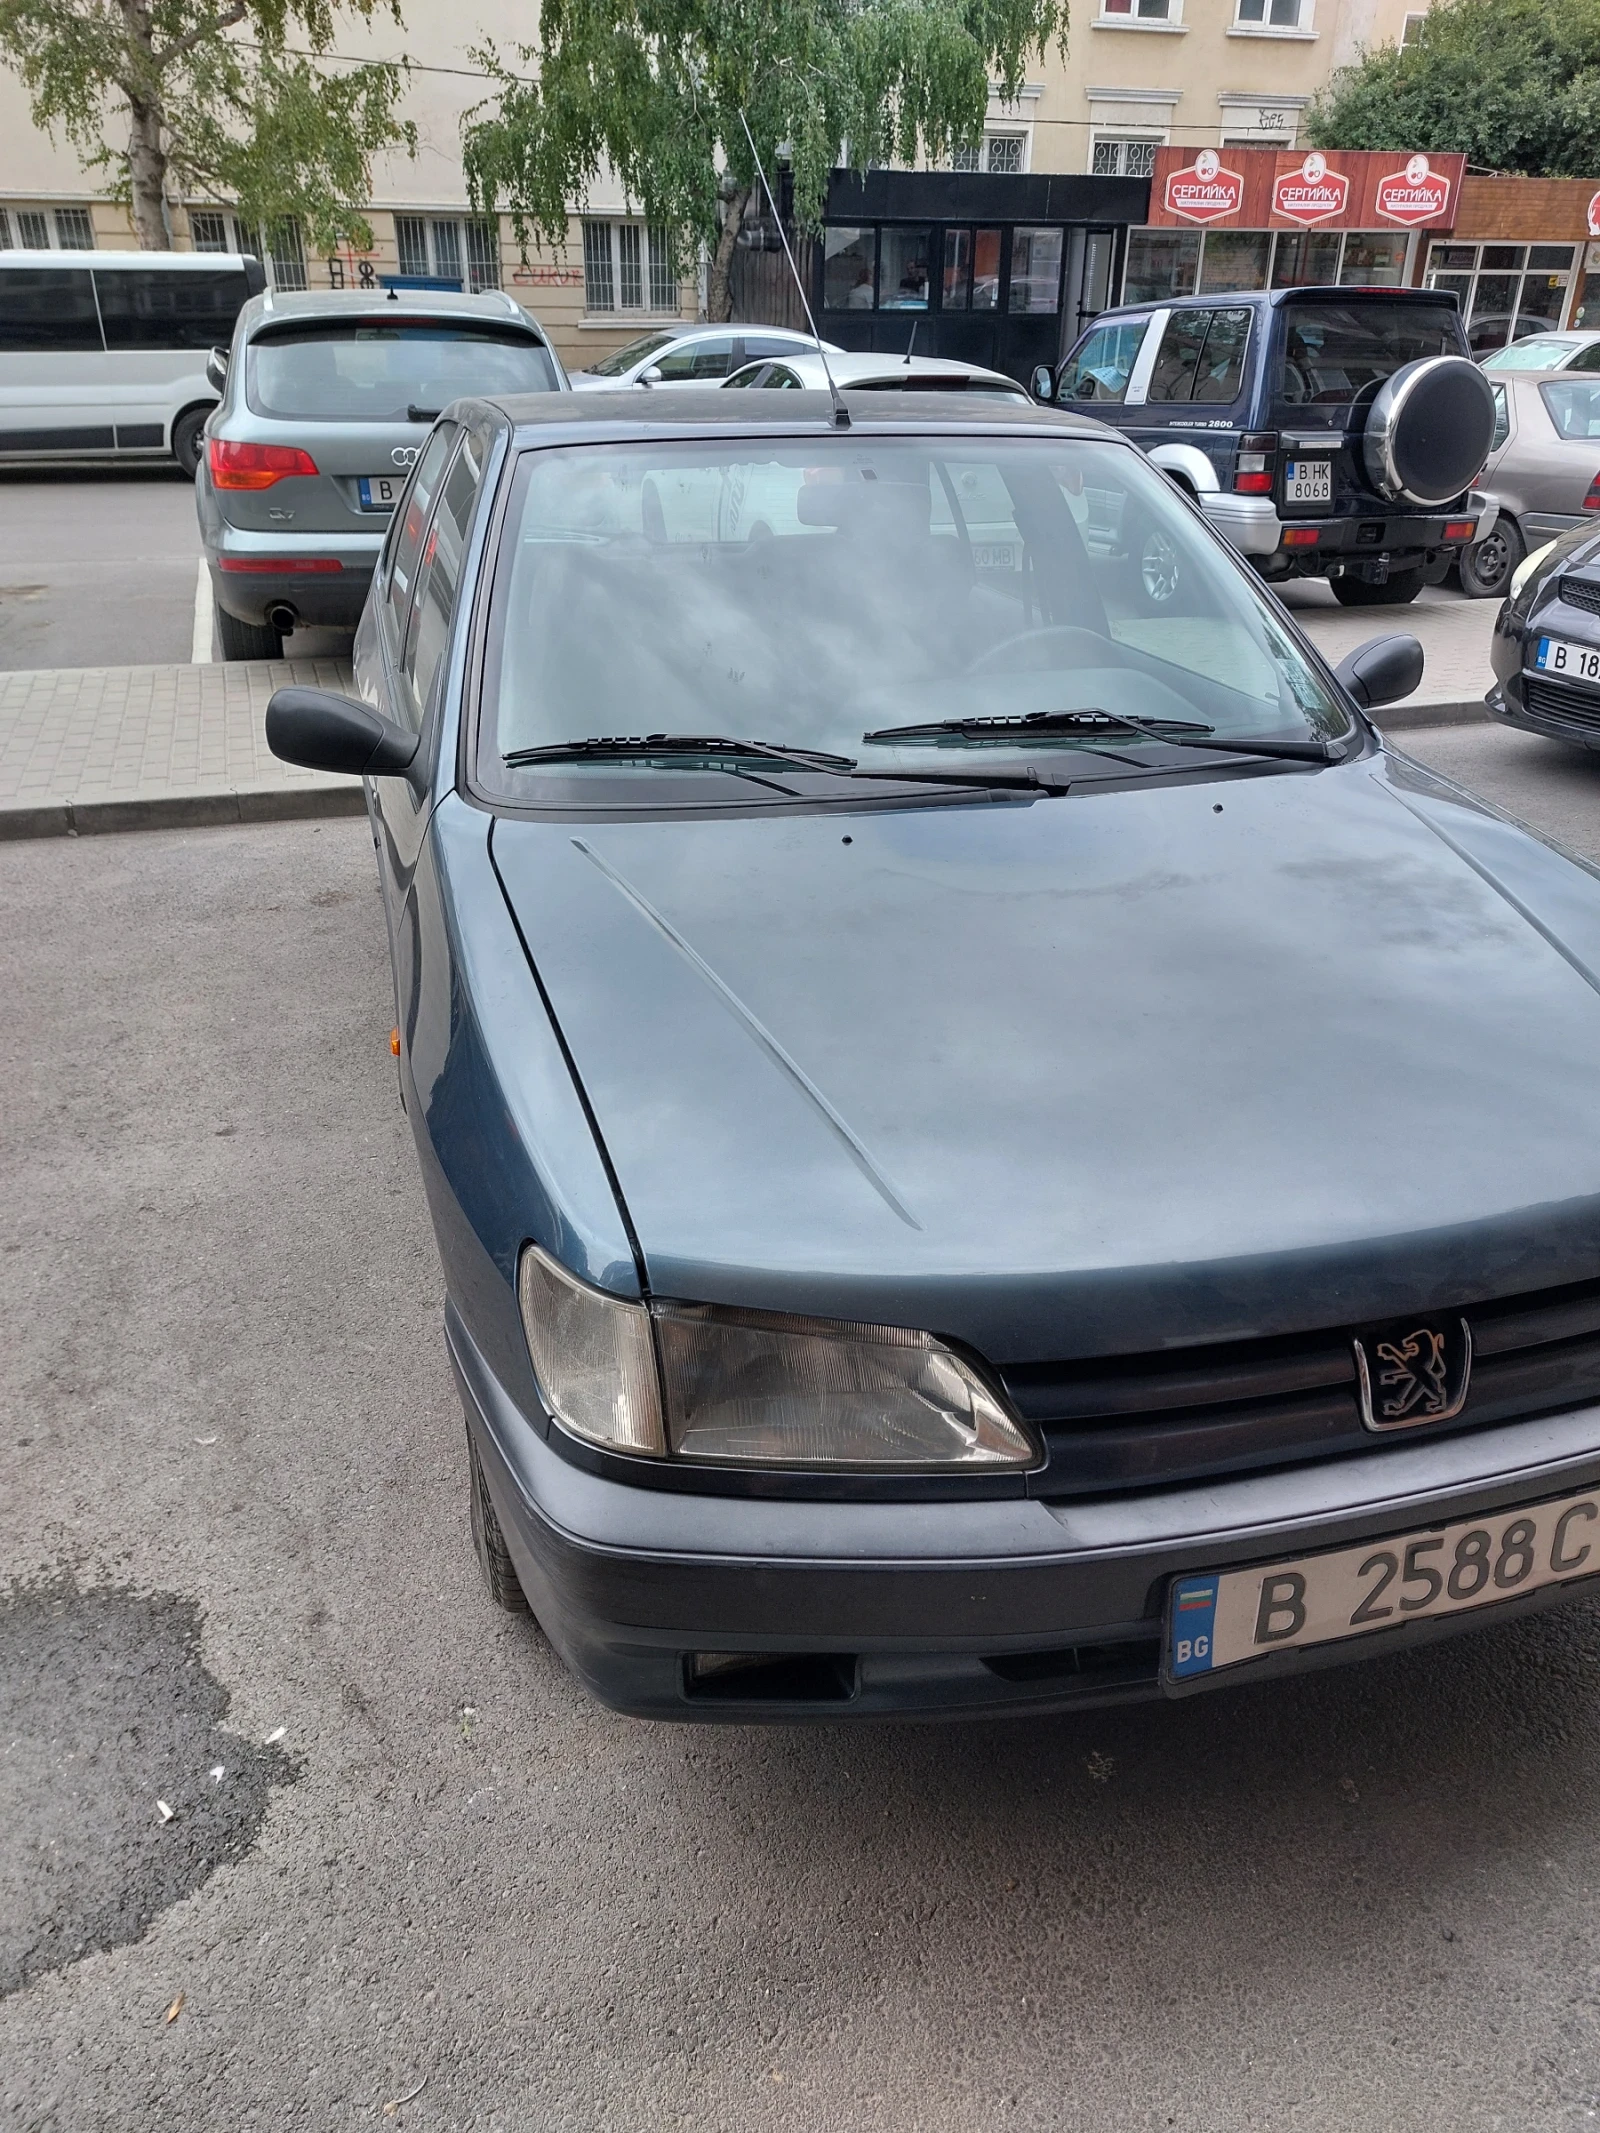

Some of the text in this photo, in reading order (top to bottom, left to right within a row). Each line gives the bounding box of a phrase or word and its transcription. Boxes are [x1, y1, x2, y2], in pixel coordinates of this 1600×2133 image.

[1171, 184, 1236, 199] СЕРГИЙКА
[1279, 185, 1341, 201] СЕРГИЙКА
[1382, 187, 1442, 202] СЕРГИЙКА
[1207, 420, 1234, 428] 2800
[1299, 464, 1330, 480] B HK
[1295, 482, 1329, 498] 8068
[1554, 646, 1600, 679] B 18
[1254, 1502, 1599, 1645] B 2588 C
[1177, 1635, 1209, 1664] BG
